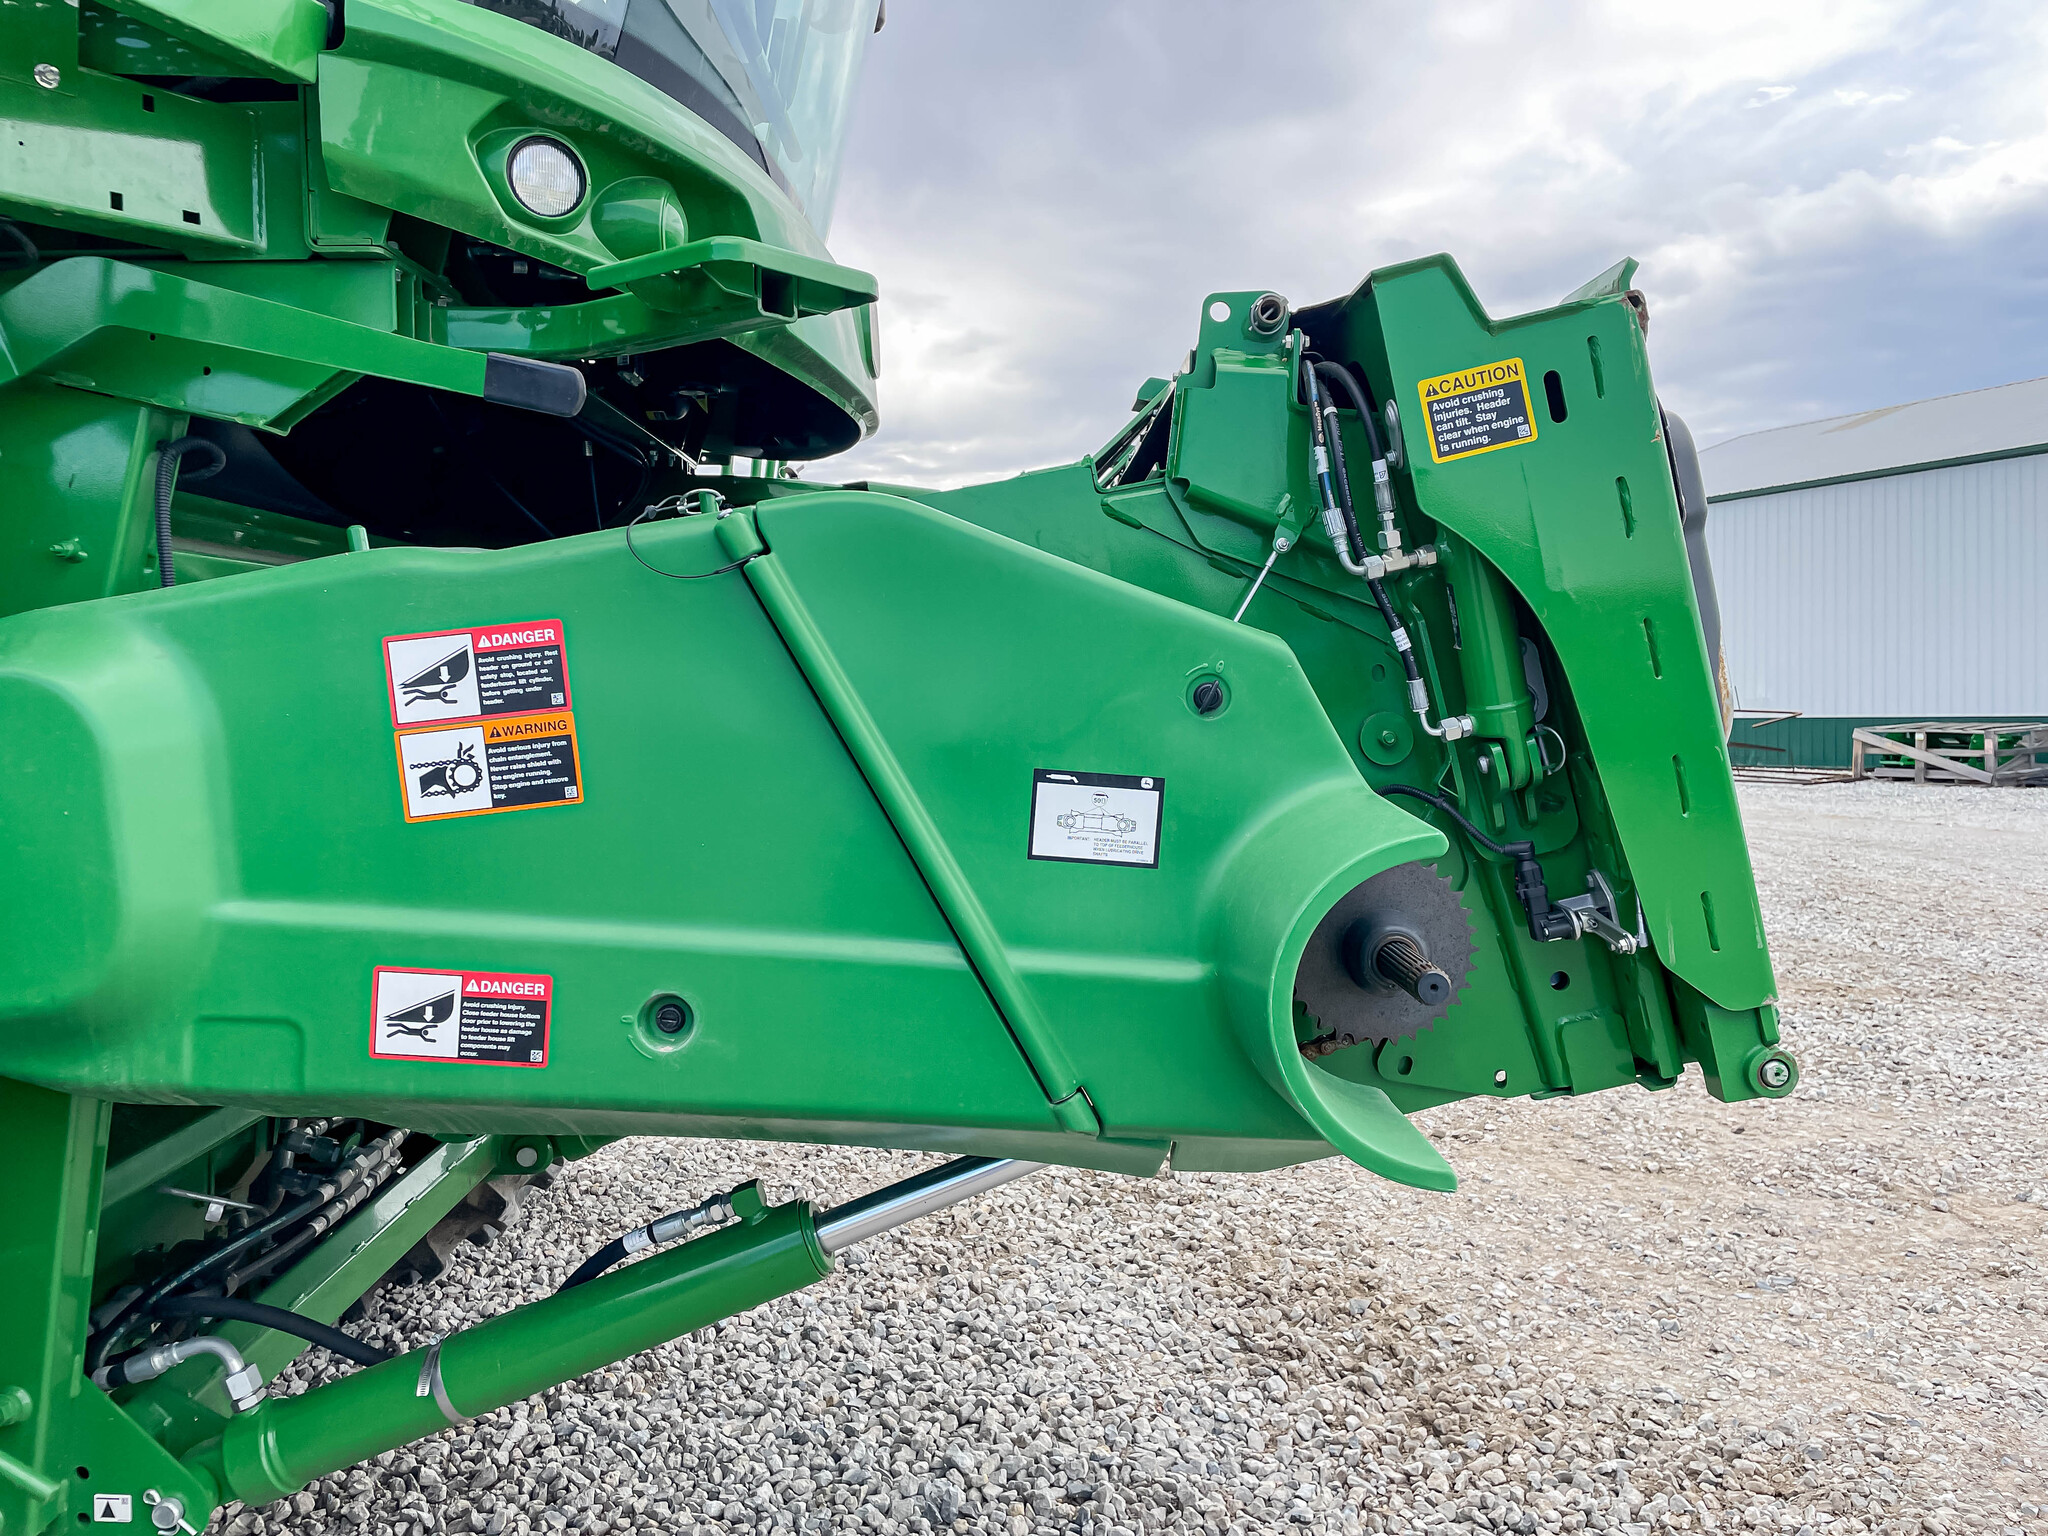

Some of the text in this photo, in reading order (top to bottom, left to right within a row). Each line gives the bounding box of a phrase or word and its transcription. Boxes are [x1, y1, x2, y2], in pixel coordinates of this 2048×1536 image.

[1440, 363, 1519, 394] CAUTION
[1433, 389, 1504, 412] Avoid crushing
[1434, 398, 1510, 422] injuries. Header
[1436, 412, 1497, 431] can tilt. Stay
[1439, 416, 1524, 442] clear when engine
[1440, 435, 1491, 452] is running.
[492, 629, 555, 647] DANGER
[512, 661, 532, 669] ground
[503, 688, 523, 696] getting
[502, 720, 568, 738] WARNING
[508, 751, 552, 761] entanglement.
[527, 760, 547, 768] shield
[481, 981, 545, 996] DANGER
[500, 1020, 525, 1028] lowering
